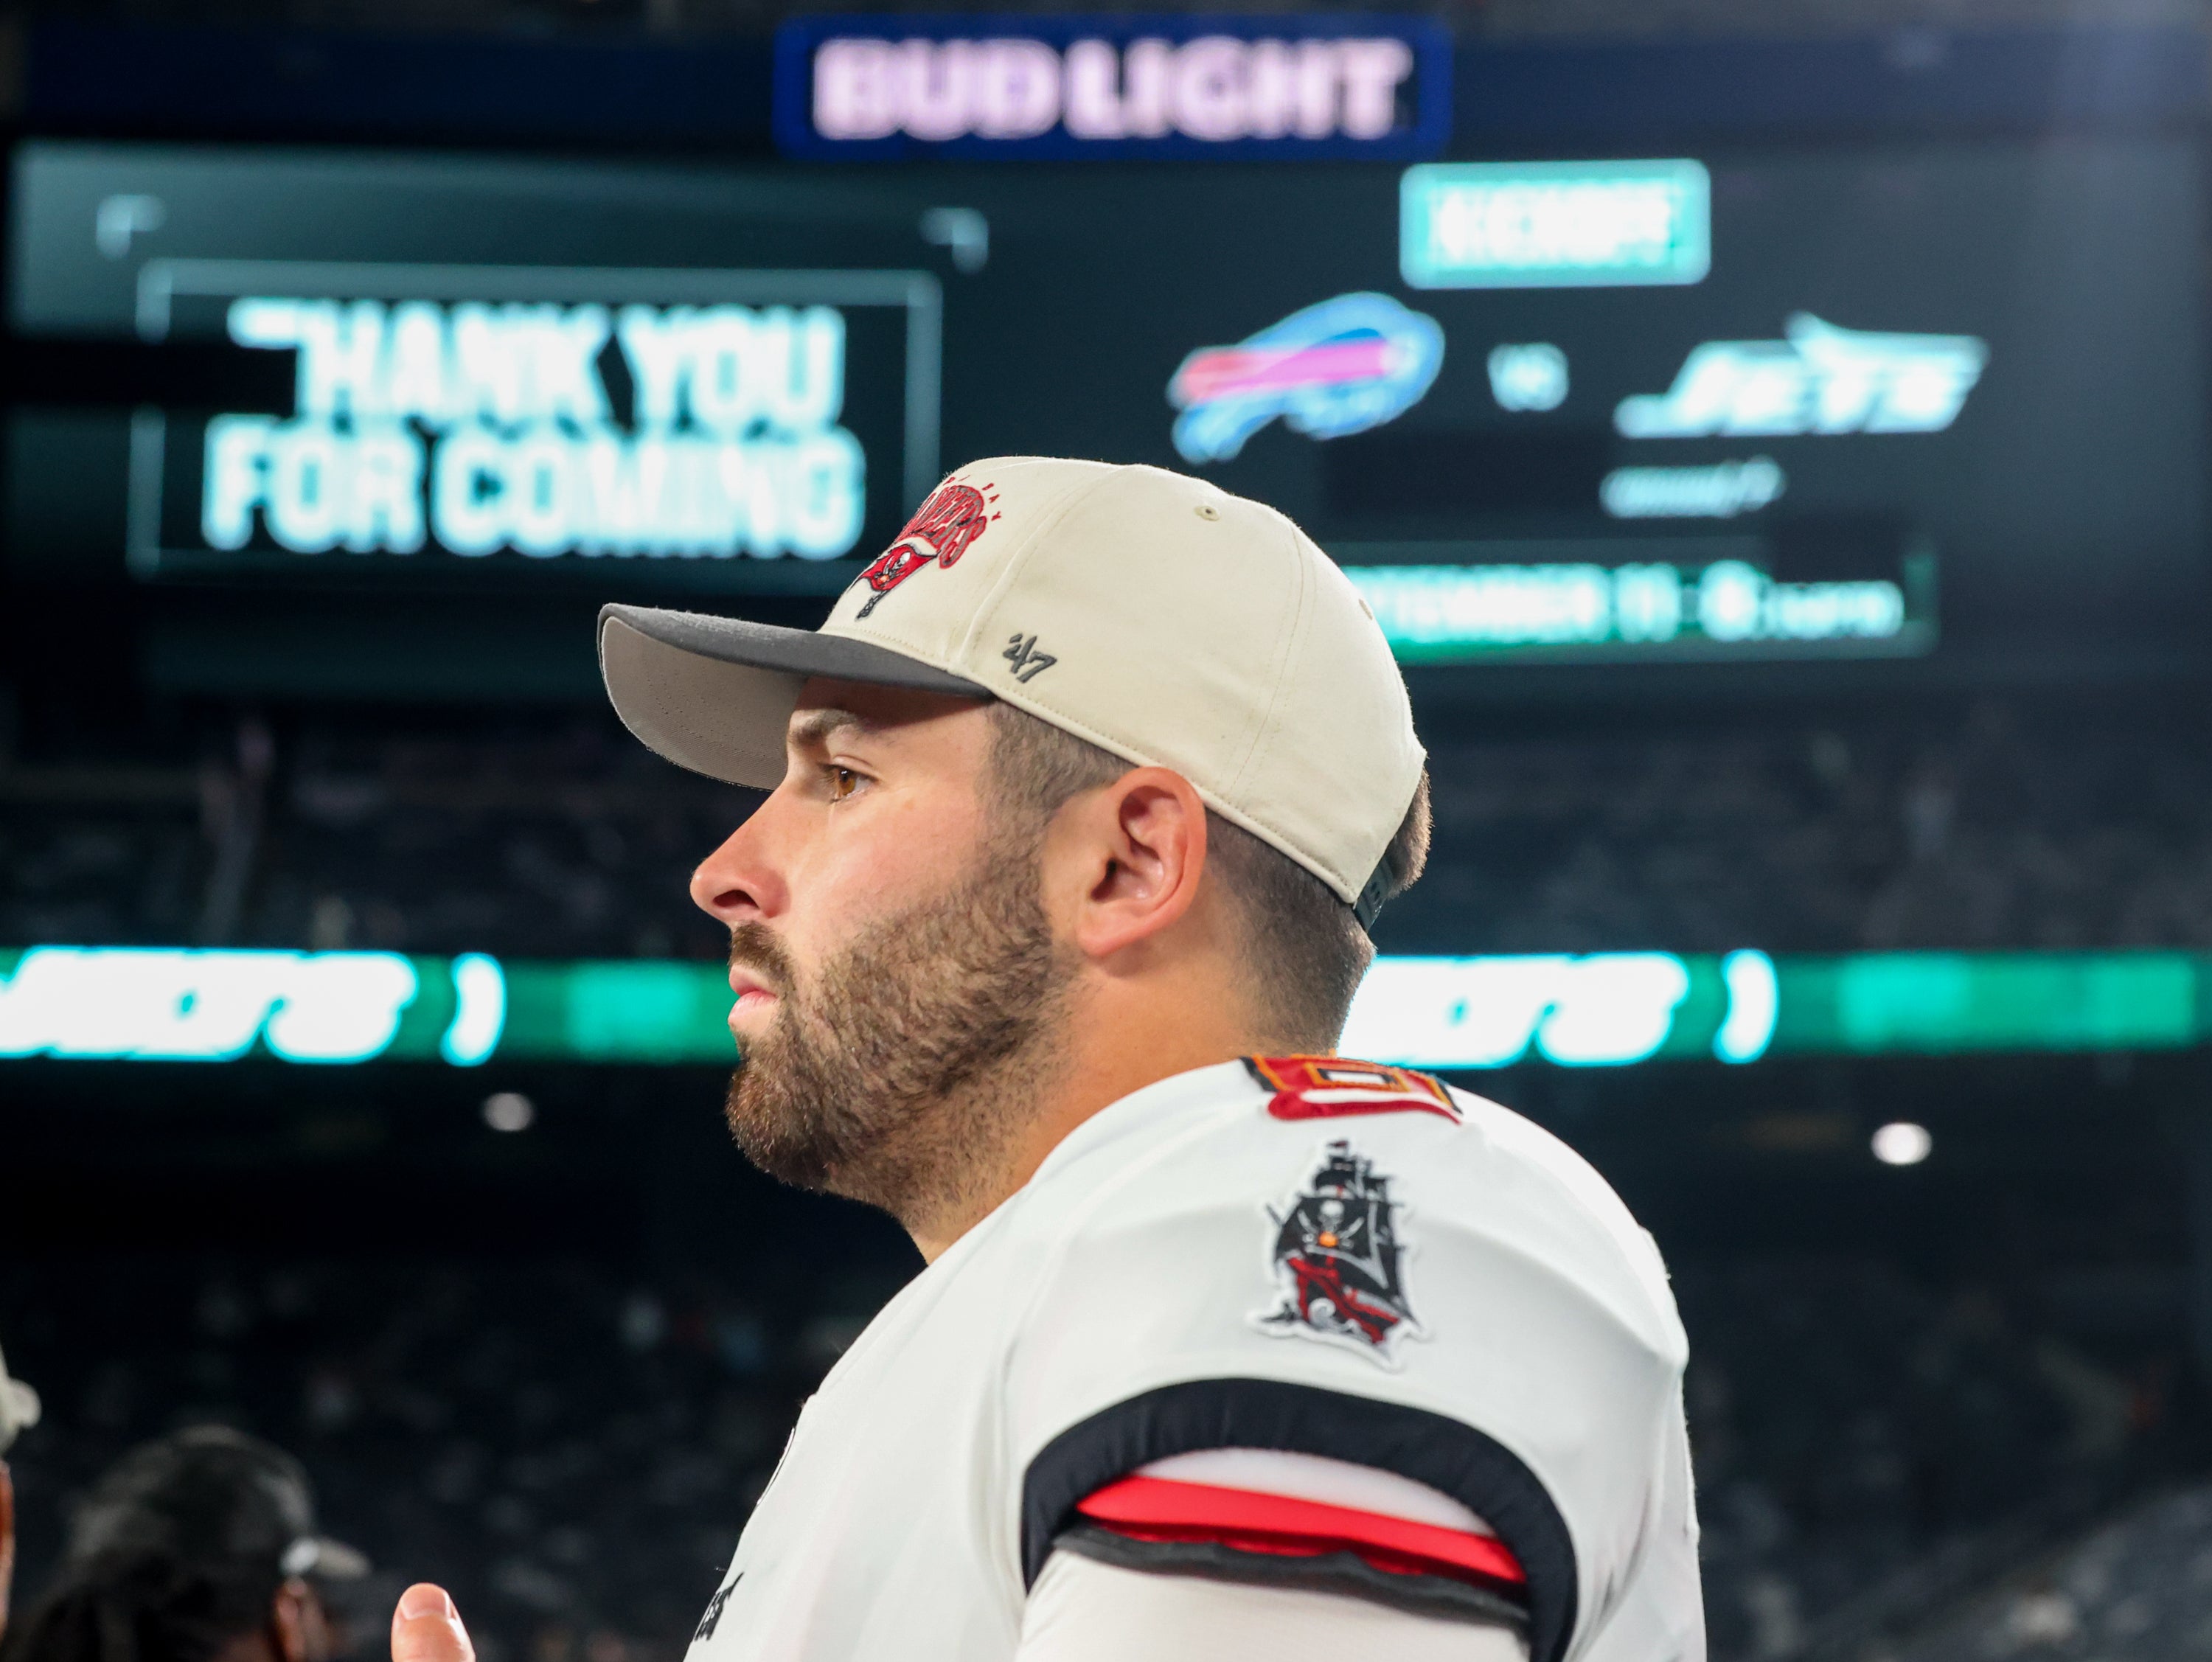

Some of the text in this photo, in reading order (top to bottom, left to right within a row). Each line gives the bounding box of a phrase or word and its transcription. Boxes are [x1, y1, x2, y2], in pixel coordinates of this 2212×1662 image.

[813, 37, 1411, 140] BUD LIGHT
[225, 298, 846, 429] THANK YOU
[201, 416, 428, 552] FOR
[432, 426, 865, 559] COMING
